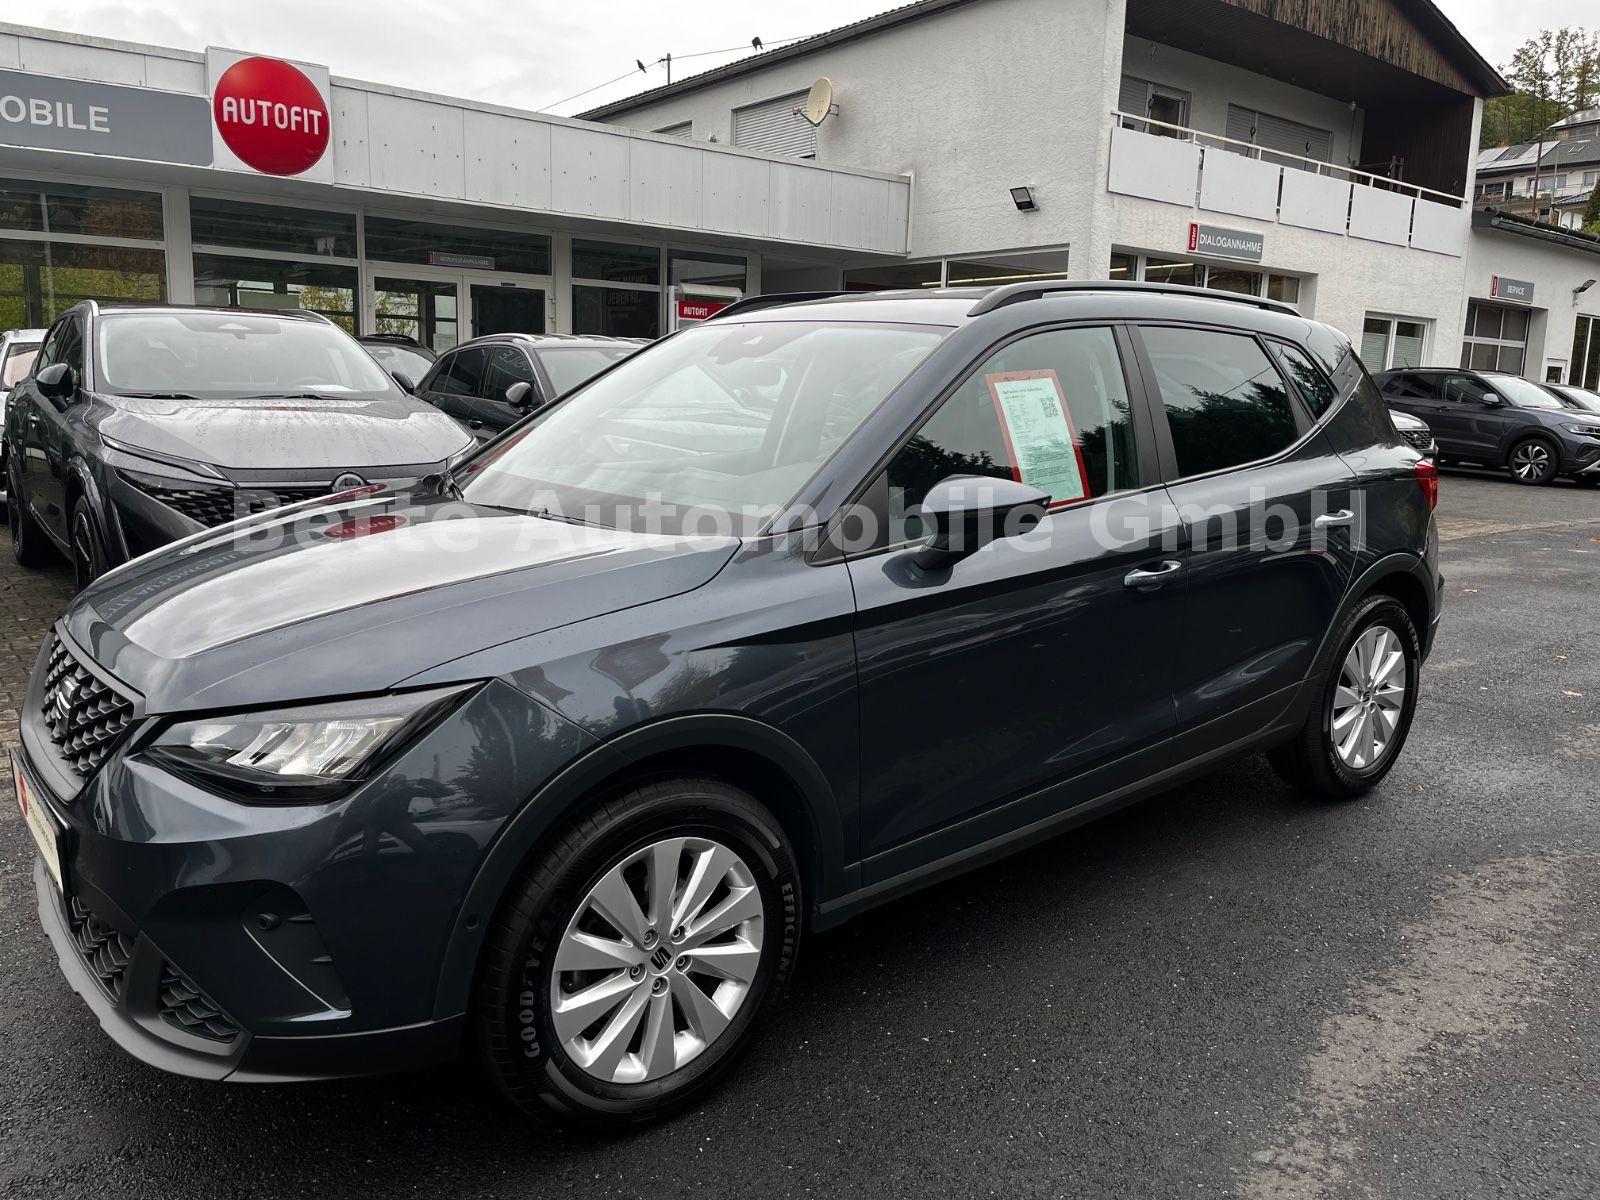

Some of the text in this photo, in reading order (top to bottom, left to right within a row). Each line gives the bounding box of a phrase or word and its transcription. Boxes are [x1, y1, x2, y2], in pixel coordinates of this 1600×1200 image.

[0, 95, 110, 133] OBILE
[222, 96, 322, 136] AUTOFIT
[1200, 234, 1262, 252] DIALOGANNAHME
[1506, 285, 1526, 296] SERVICE
[683, 306, 708, 316] AUTOFIT
